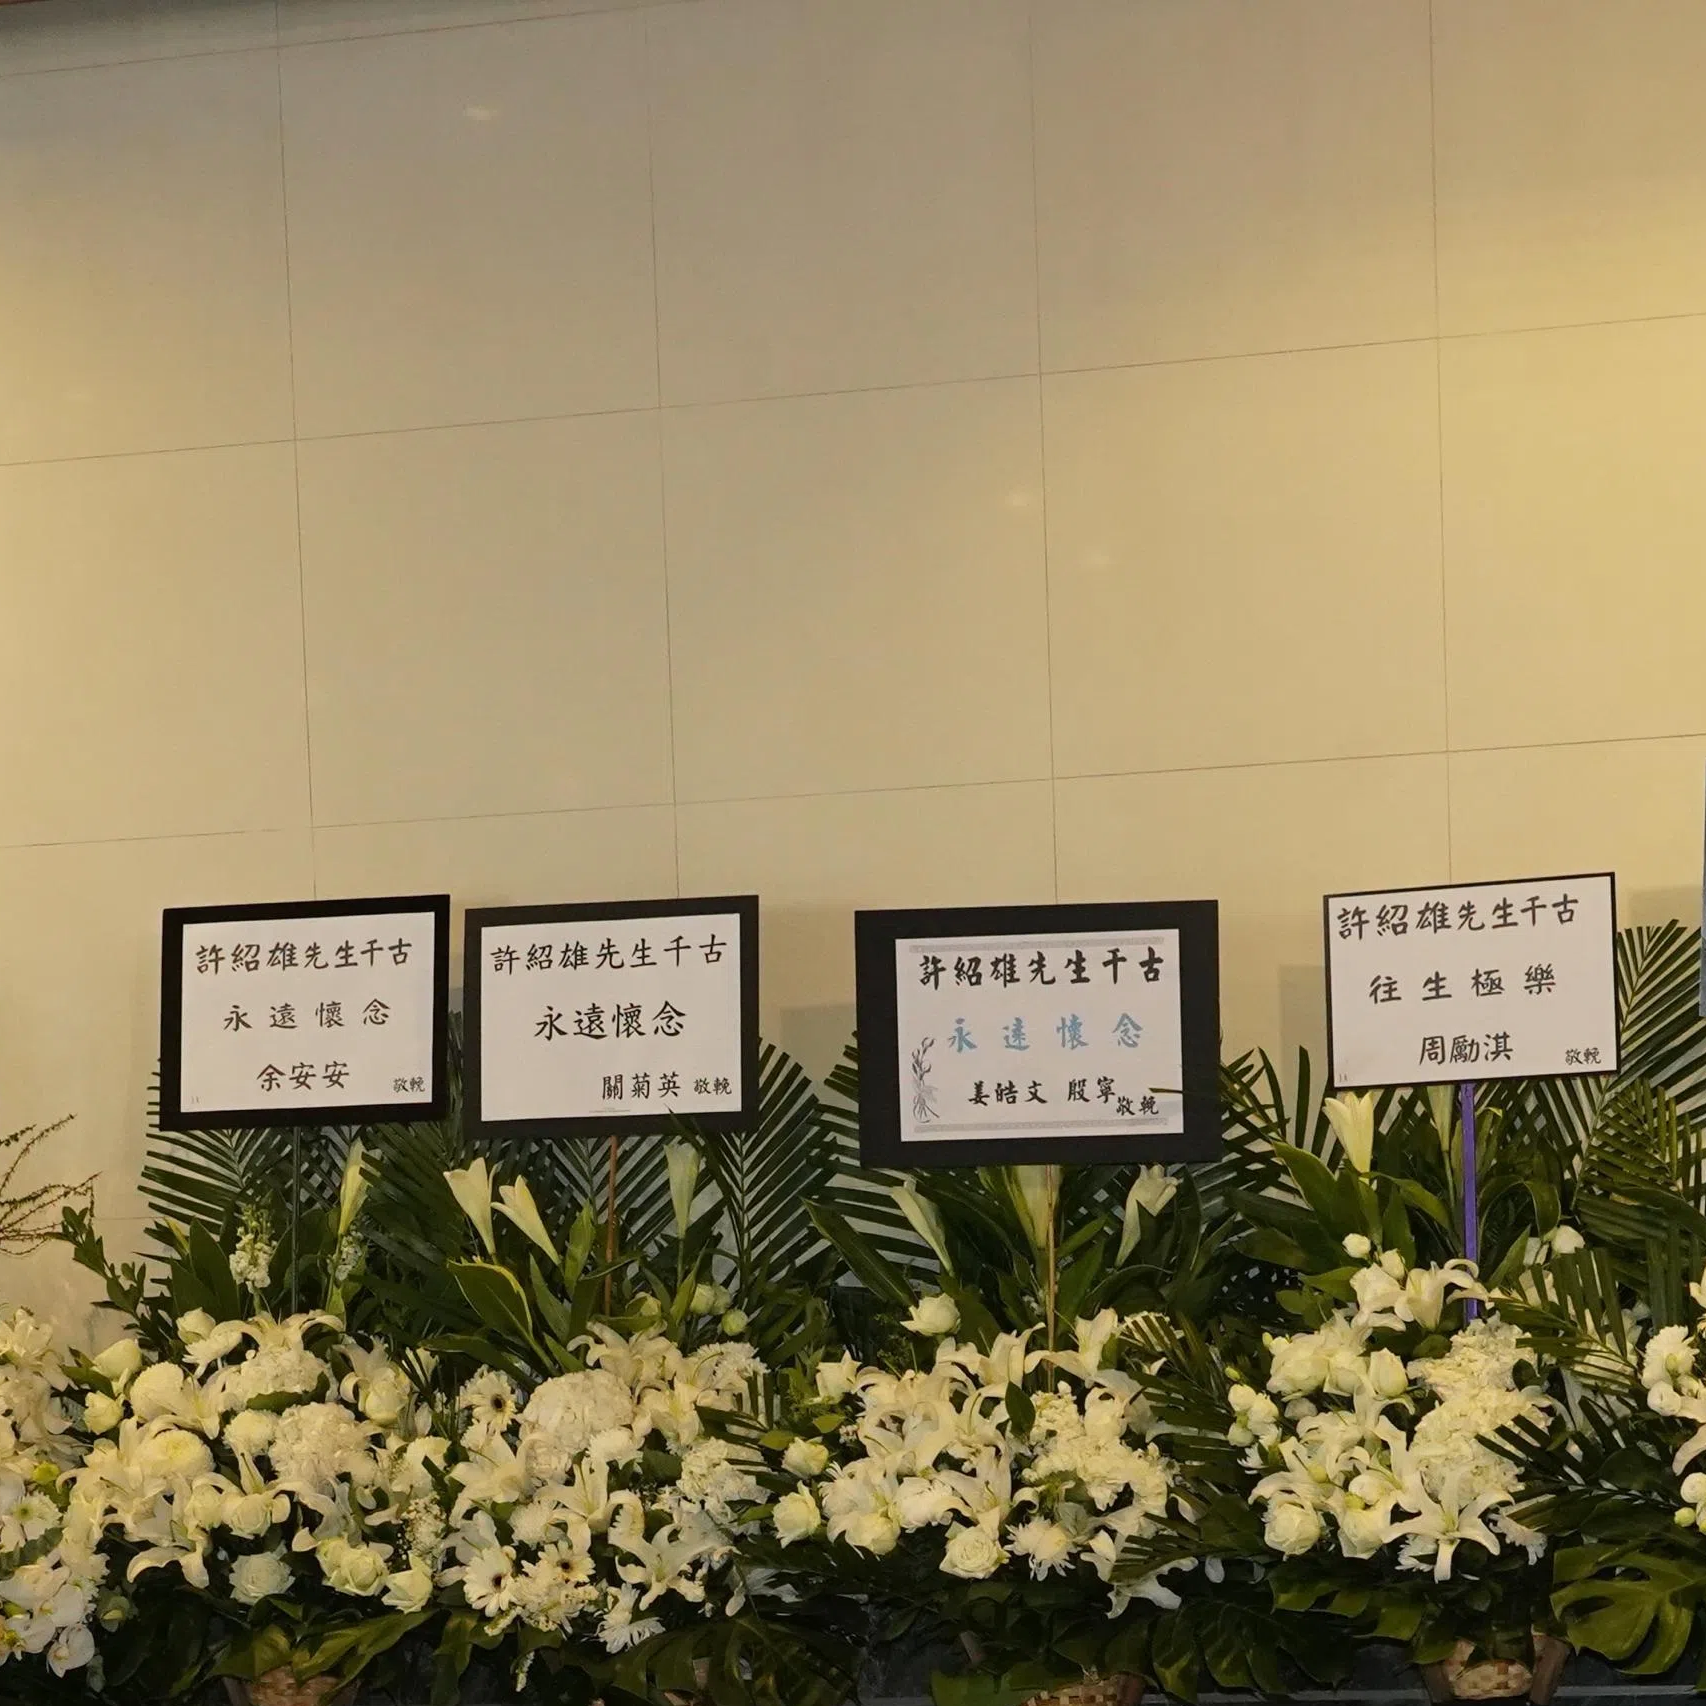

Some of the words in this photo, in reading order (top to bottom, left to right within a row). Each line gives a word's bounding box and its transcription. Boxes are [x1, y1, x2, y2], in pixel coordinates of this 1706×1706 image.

[1337, 893, 1578, 940] 許紹雄先生千古
[196, 938, 412, 975] 許紹雄先生千古
[490, 934, 727, 975] 許紹雄先生千古
[919, 946, 1164, 990] 許紹雄先生千古
[1369, 963, 1556, 1004] 往生極樂
[224, 998, 390, 1032] 永遠懷念
[534, 1000, 686, 1041] 永遠懷念
[948, 1012, 1144, 1053] 永遠懷念
[1566, 1048, 1601, 1065] 敬輓
[257, 1061, 349, 1092] 余安安
[394, 1077, 425, 1093] 敬輓
[602, 1071, 681, 1100] 關菊英
[694, 1077, 732, 1095] 敬輓
[968, 1080, 1048, 1106] 姜皓文
